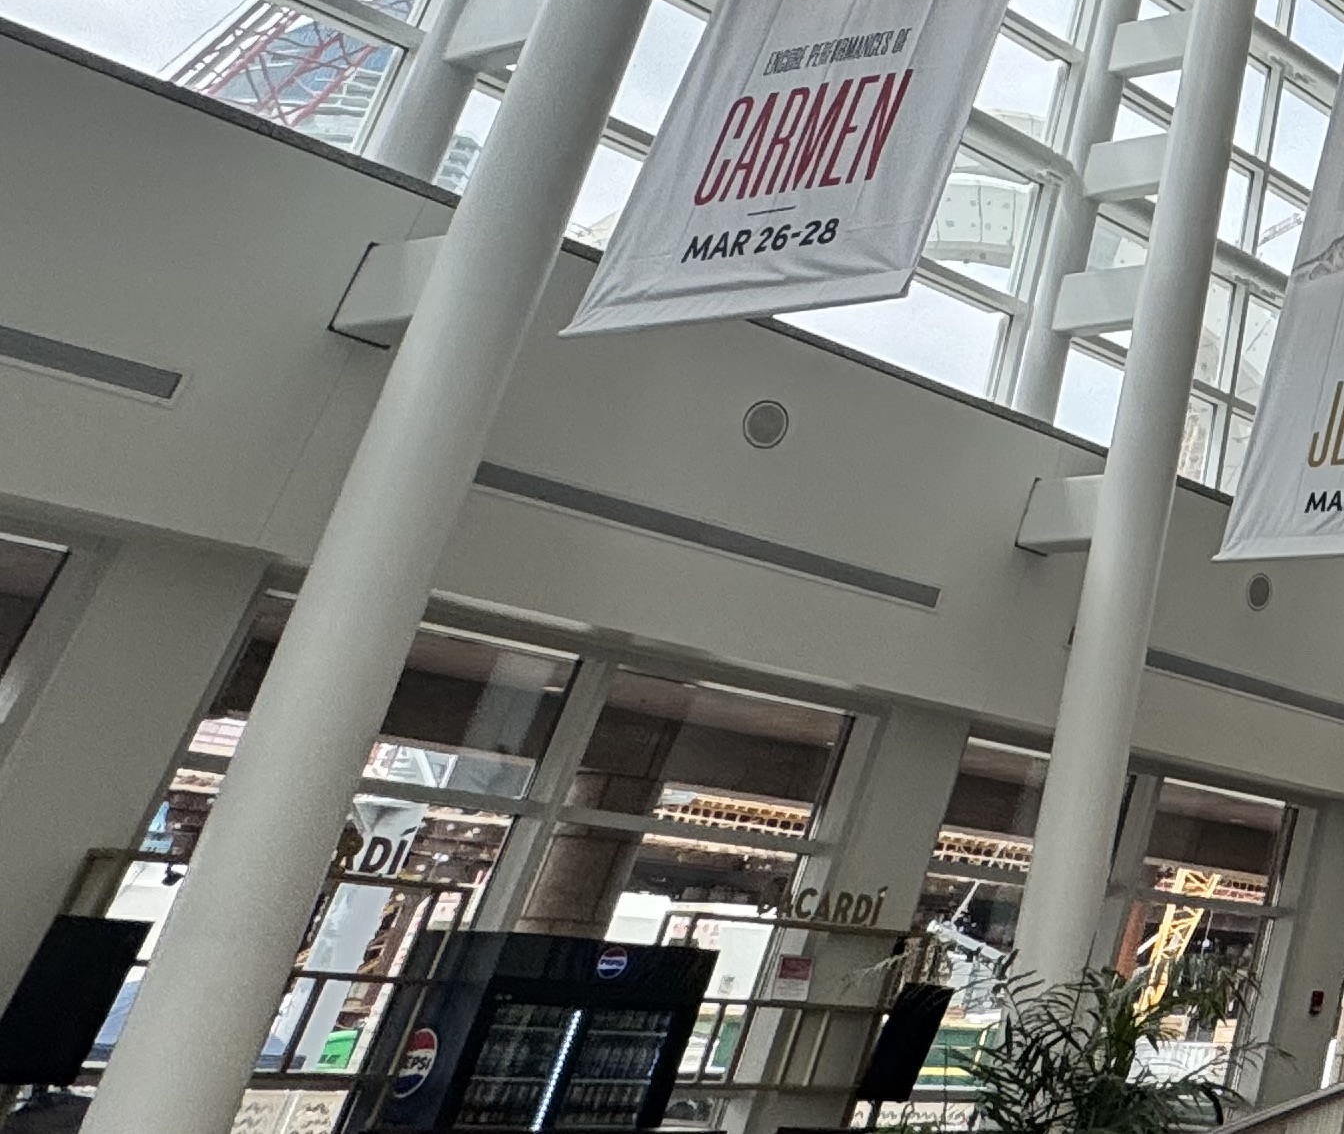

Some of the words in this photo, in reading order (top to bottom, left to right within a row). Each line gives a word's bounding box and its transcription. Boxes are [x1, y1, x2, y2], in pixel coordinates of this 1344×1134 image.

[892, 28, 912, 54] OF
[695, 69, 913, 205] CARMEN
[681, 229, 751, 264] MAR
[753, 218, 839, 254] 26-28
